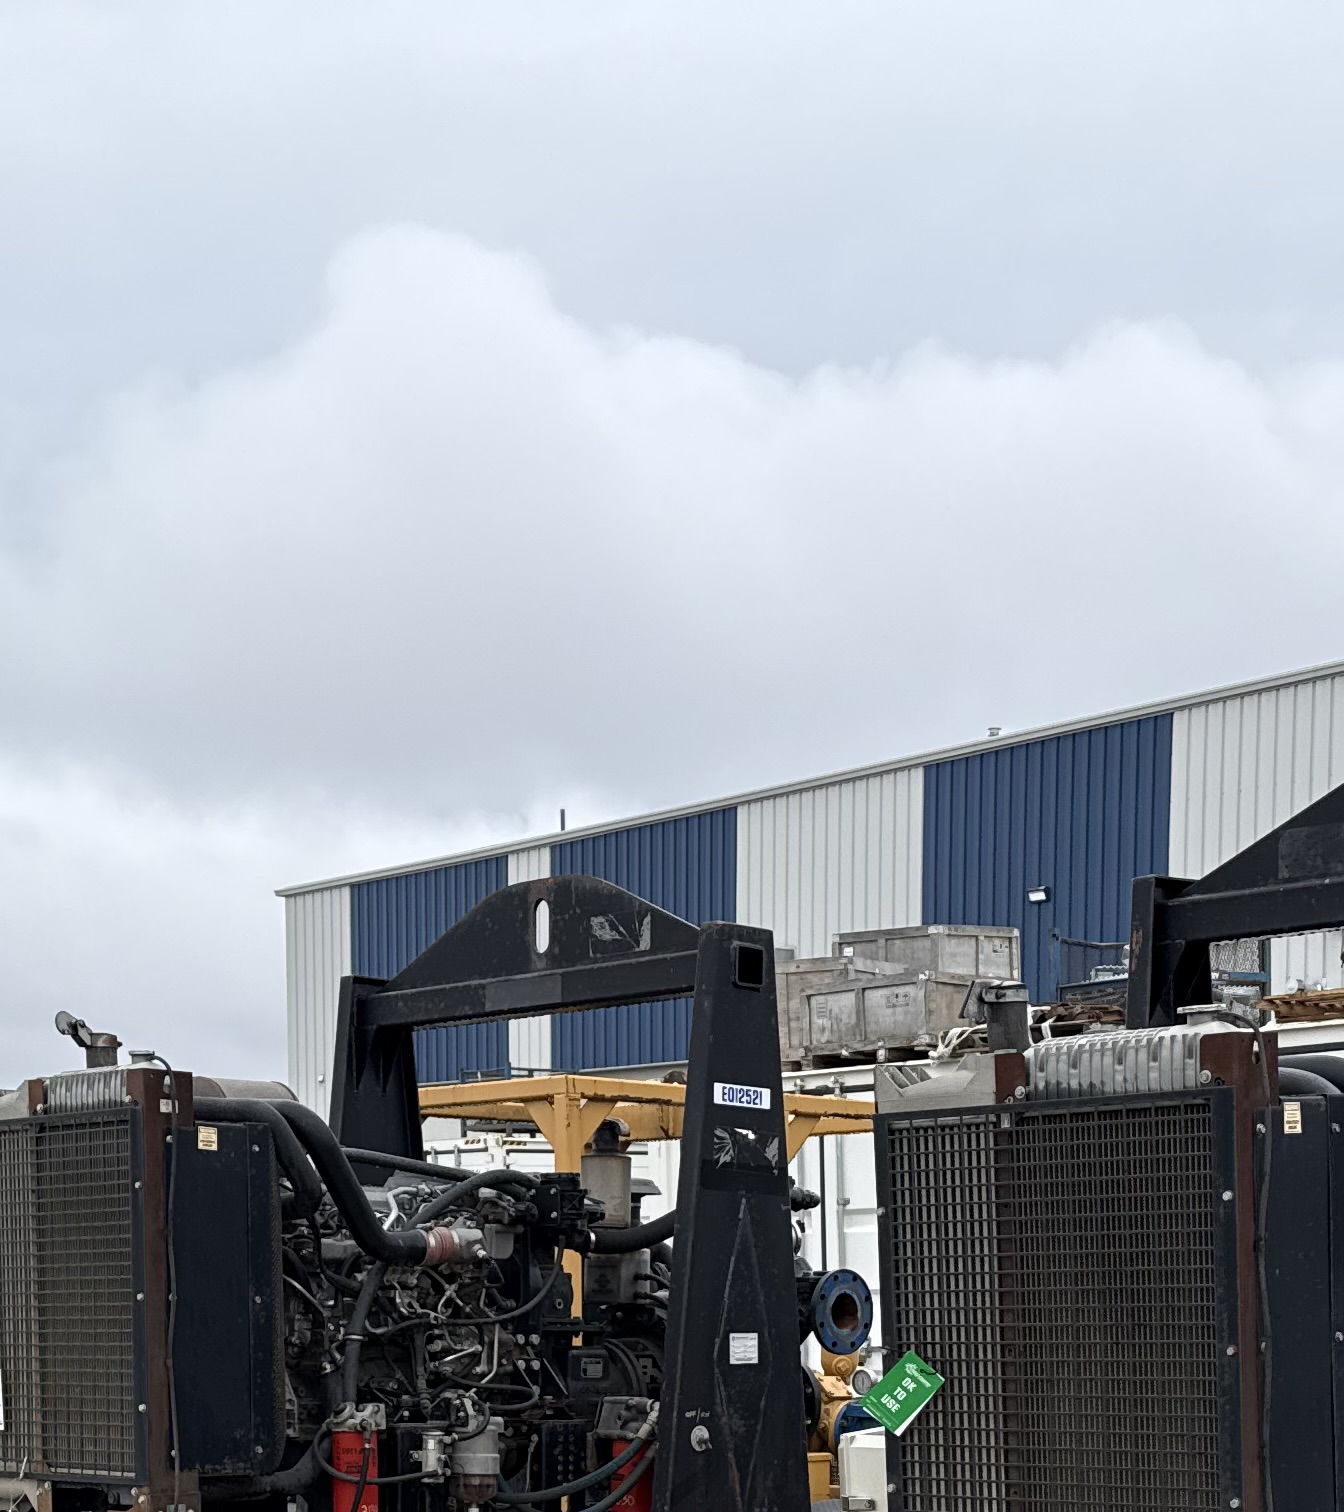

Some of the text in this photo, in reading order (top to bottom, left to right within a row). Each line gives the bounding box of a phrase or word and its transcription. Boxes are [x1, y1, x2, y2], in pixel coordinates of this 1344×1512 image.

[721, 1085, 763, 1106] E012521
[892, 1386, 908, 1401] TO
[901, 1376, 918, 1393] OK
[880, 1393, 902, 1414] USE
